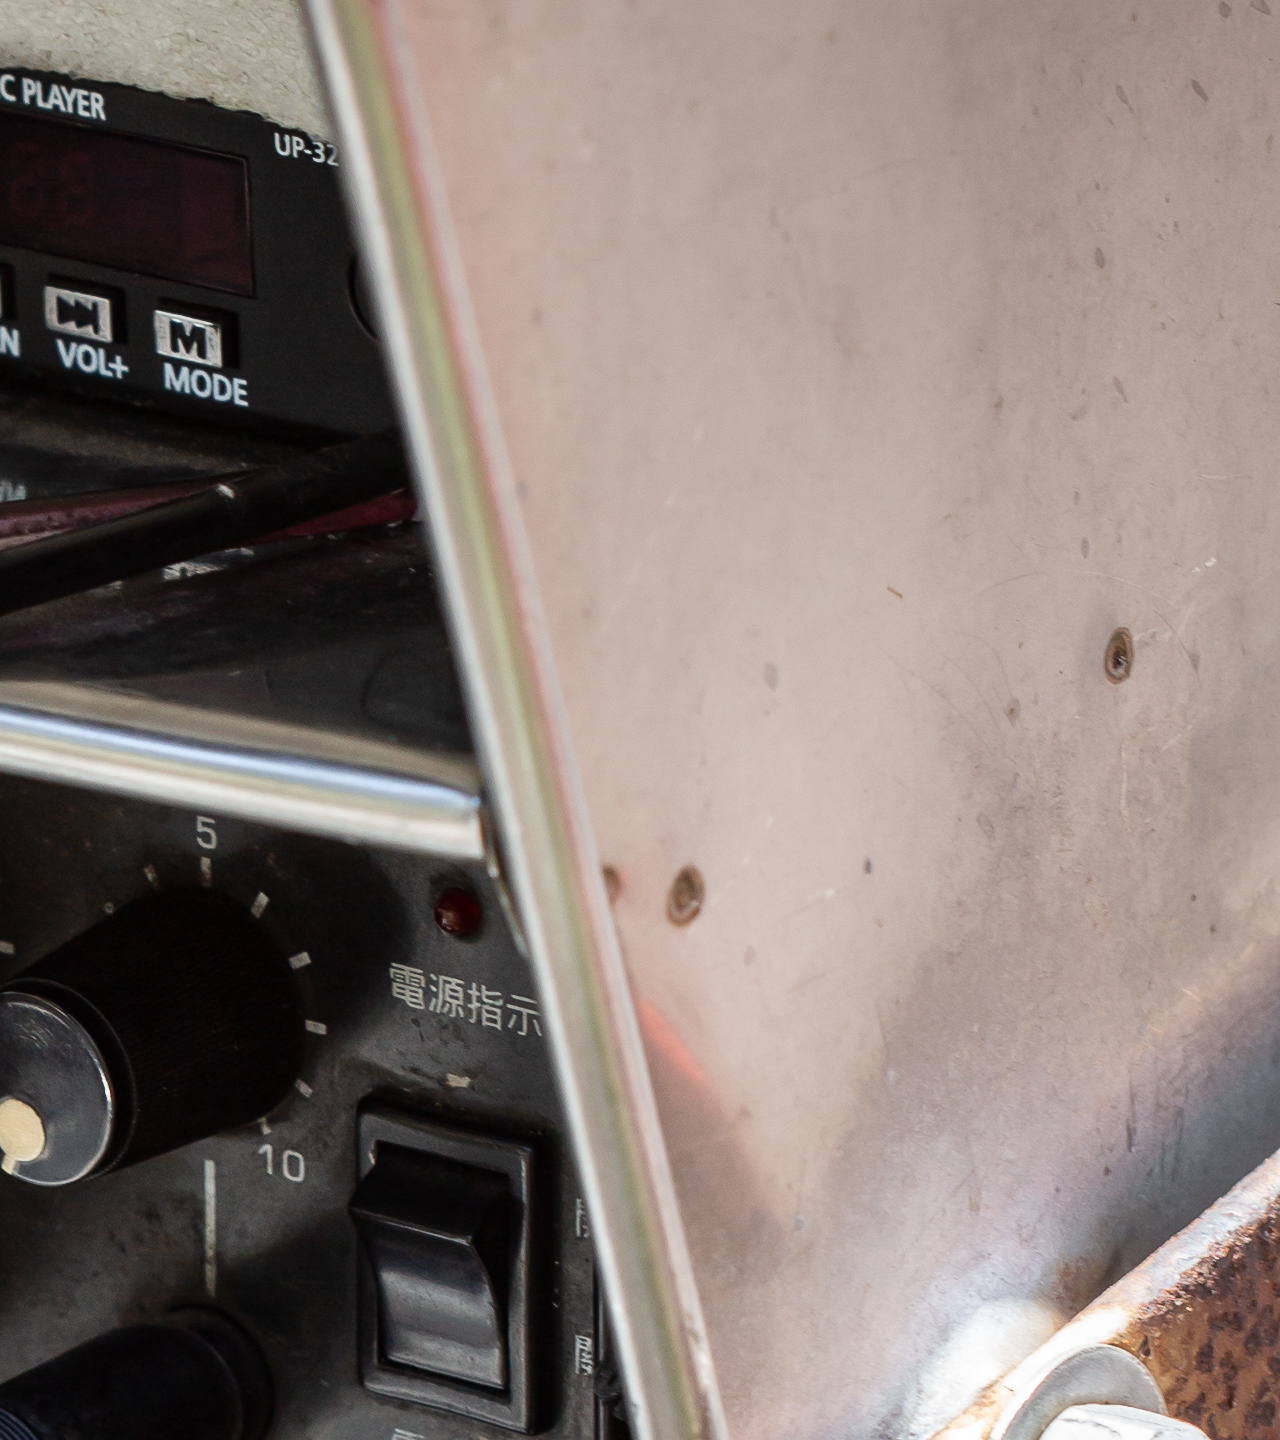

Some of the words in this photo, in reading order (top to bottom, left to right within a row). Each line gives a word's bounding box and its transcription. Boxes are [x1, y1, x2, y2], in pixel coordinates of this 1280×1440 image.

[22, 76, 107, 122] PLAYER
[56, 338, 130, 379] VOL+
[163, 362, 249, 408] MODE
[195, 815, 218, 850] 5
[389, 962, 543, 1037] 電源指示
[258, 1143, 306, 1183] 10
